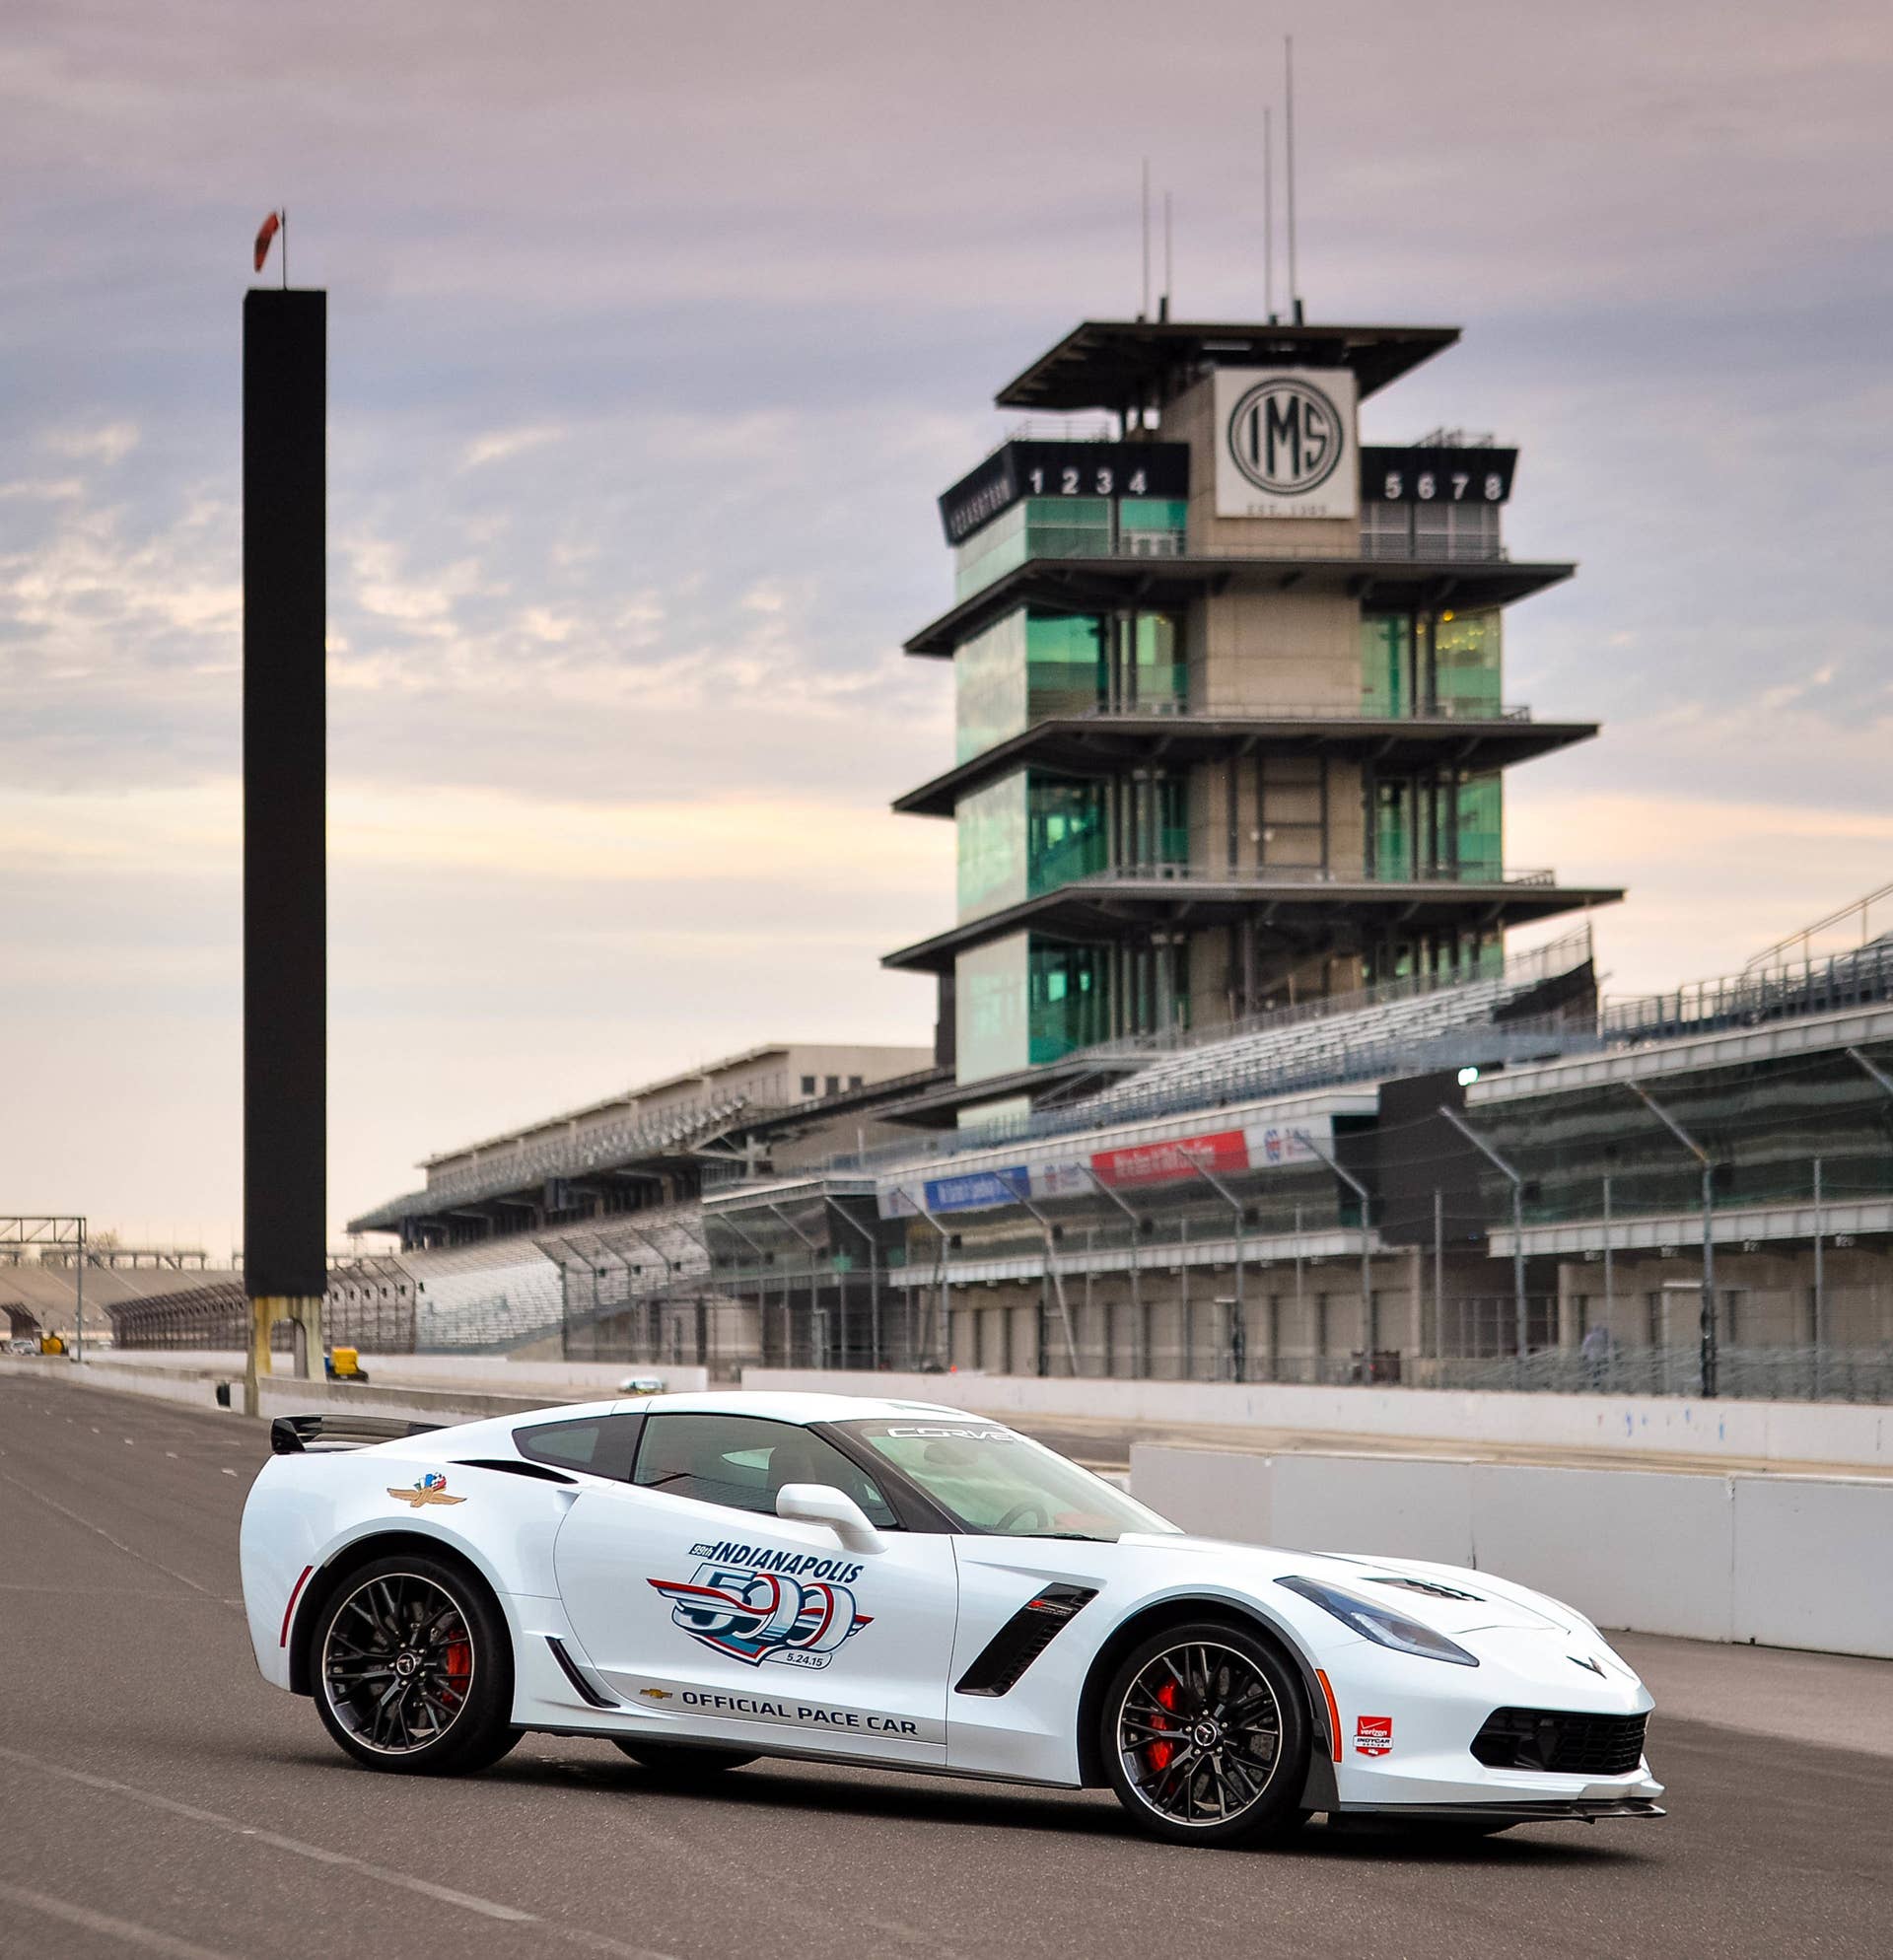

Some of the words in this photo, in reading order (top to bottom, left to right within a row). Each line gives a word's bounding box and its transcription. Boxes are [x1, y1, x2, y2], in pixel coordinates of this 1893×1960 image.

[1250, 395, 1327, 479] IMS
[1030, 469, 1043, 494] 1
[1062, 468, 1080, 495] 2
[1095, 468, 1113, 495] 3
[1129, 469, 1147, 495] 4
[1384, 473, 1403, 500] 5
[1417, 473, 1436, 500] 6
[1451, 473, 1469, 501] 7
[1484, 473, 1503, 501] 8
[691, 1544, 714, 1558] 99th
[708, 1541, 864, 1583] INDIANAPOLIS
[671, 1563, 858, 1653] 500
[786, 1652, 824, 1668] 5.24.15
[682, 1691, 792, 1718] OFFICIAL
[798, 1707, 861, 1728] PACE
[867, 1716, 919, 1735] CAR
